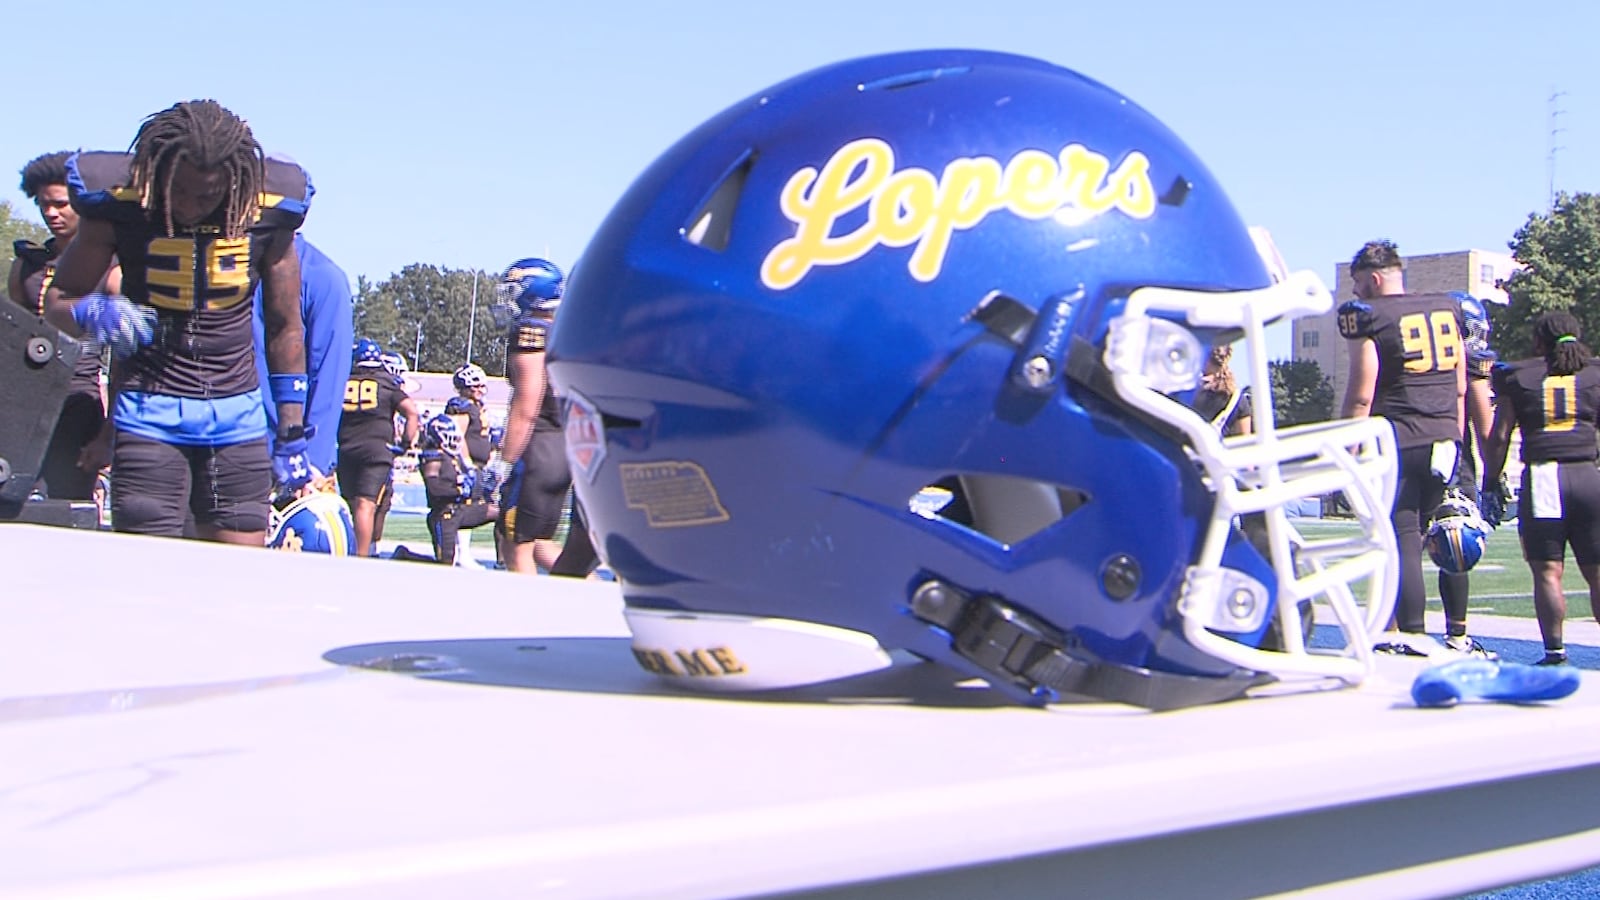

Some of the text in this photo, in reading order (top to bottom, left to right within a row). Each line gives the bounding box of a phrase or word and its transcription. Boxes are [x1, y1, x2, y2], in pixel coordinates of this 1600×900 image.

[760, 137, 1156, 290] Lopers
[1339, 312, 1358, 334] 98
[1400, 311, 1460, 373] 98
[342, 379, 379, 411] 99
[1542, 375, 1577, 432] 0
[674, 646, 748, 676] ME
